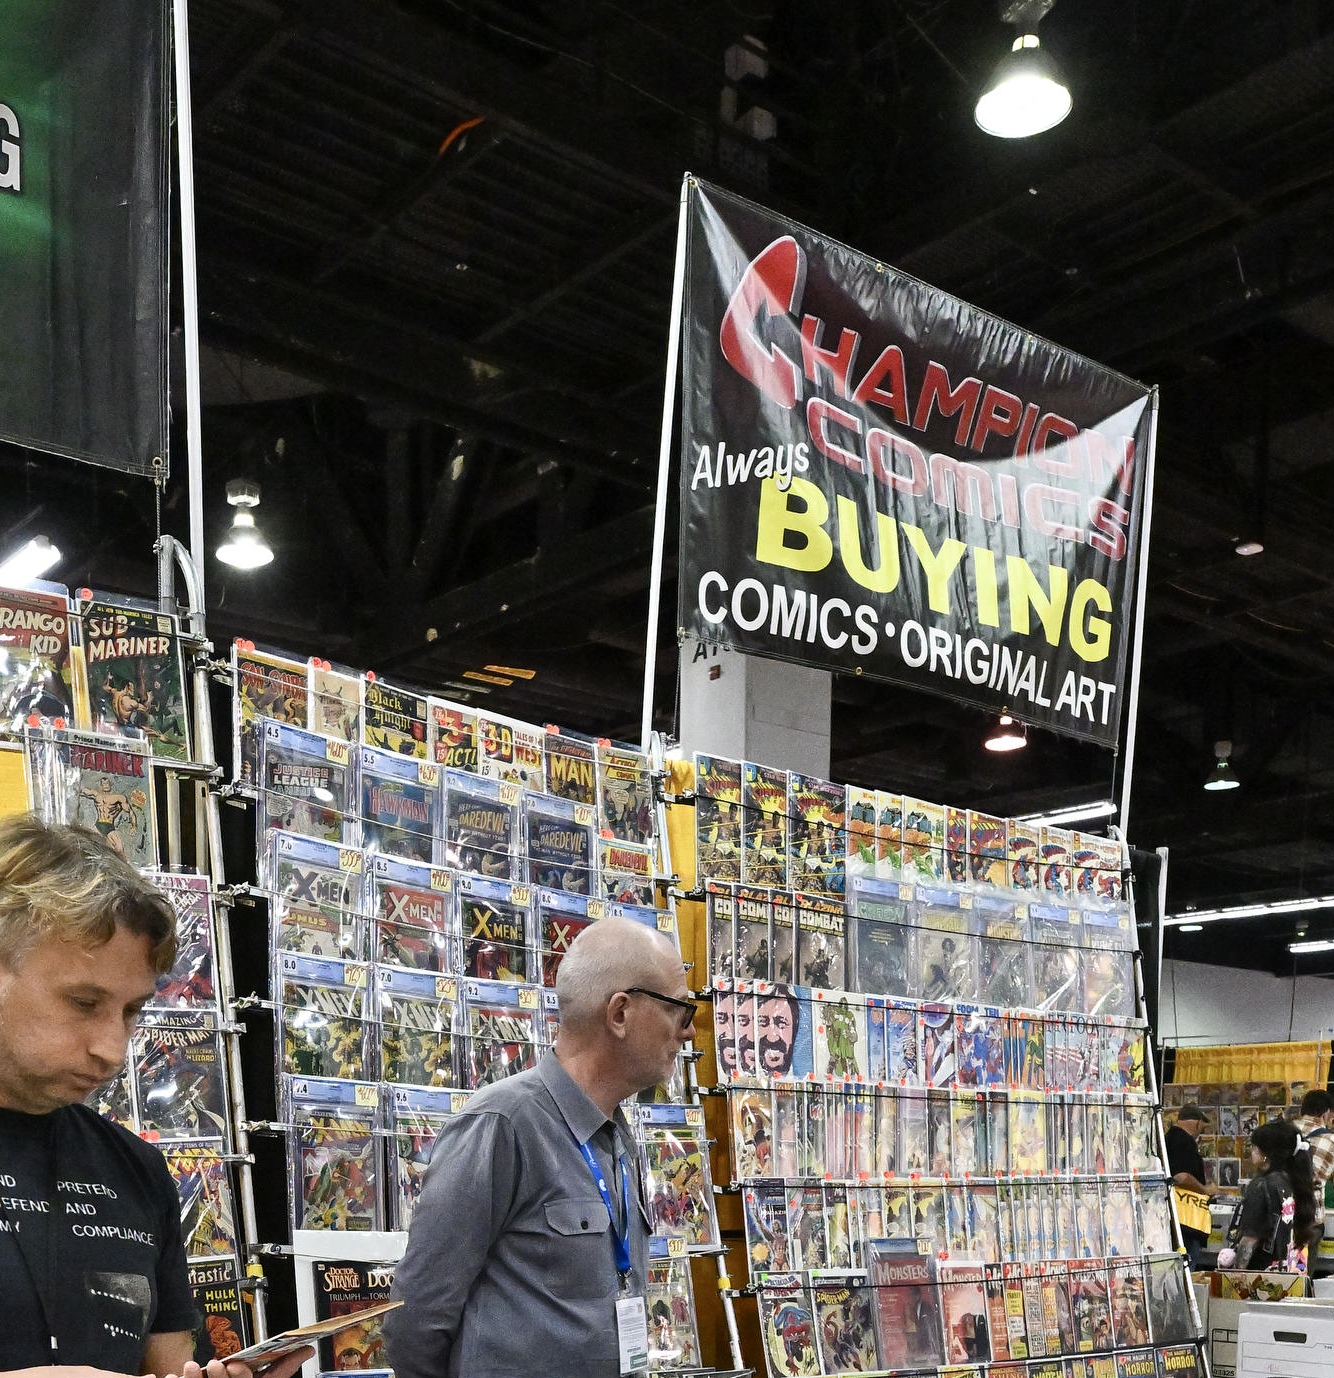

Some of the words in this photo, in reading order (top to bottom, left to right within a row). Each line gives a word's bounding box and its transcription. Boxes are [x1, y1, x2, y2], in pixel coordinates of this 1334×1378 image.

[721, 236, 1135, 497] CHAMPION
[691, 442, 810, 492] Always
[807, 397, 1129, 560] COMICS
[756, 472, 1112, 662] BUYING
[29, 634, 62, 655] KID
[89, 636, 170, 662] MARINER
[900, 619, 1050, 708] ORIGINAL
[1054, 669, 1117, 726] ART
[274, 774, 328, 788] LEAGUE
[551, 754, 593, 787] MAN
[369, 787, 429, 822] HAWKMAN
[459, 809, 506, 835] DAREDEVIL
[540, 830, 583, 853] DAREDEVIL
[388, 890, 437, 926] X-MEN
[472, 908, 519, 942] X-MEN
[799, 913, 845, 931] COMBAT
[284, 959, 296, 971] 8.0
[380, 971, 392, 983] 7.0
[468, 985, 479, 997] 9.2
[191, 1054, 217, 1063] LIZARD!
[57, 1181, 117, 1199] PRETEND
[66, 1202, 96, 1216] AND
[72, 1224, 154, 1246] COMPLIANCE
[323, 1273, 360, 1291] STRANGE
[878, 1263, 929, 1283] MONSTERS
[329, 1293, 361, 1302] TRIUMPH
[1125, 1359, 1154, 1377] HORROR
[1165, 1354, 1195, 1371] HORROR
